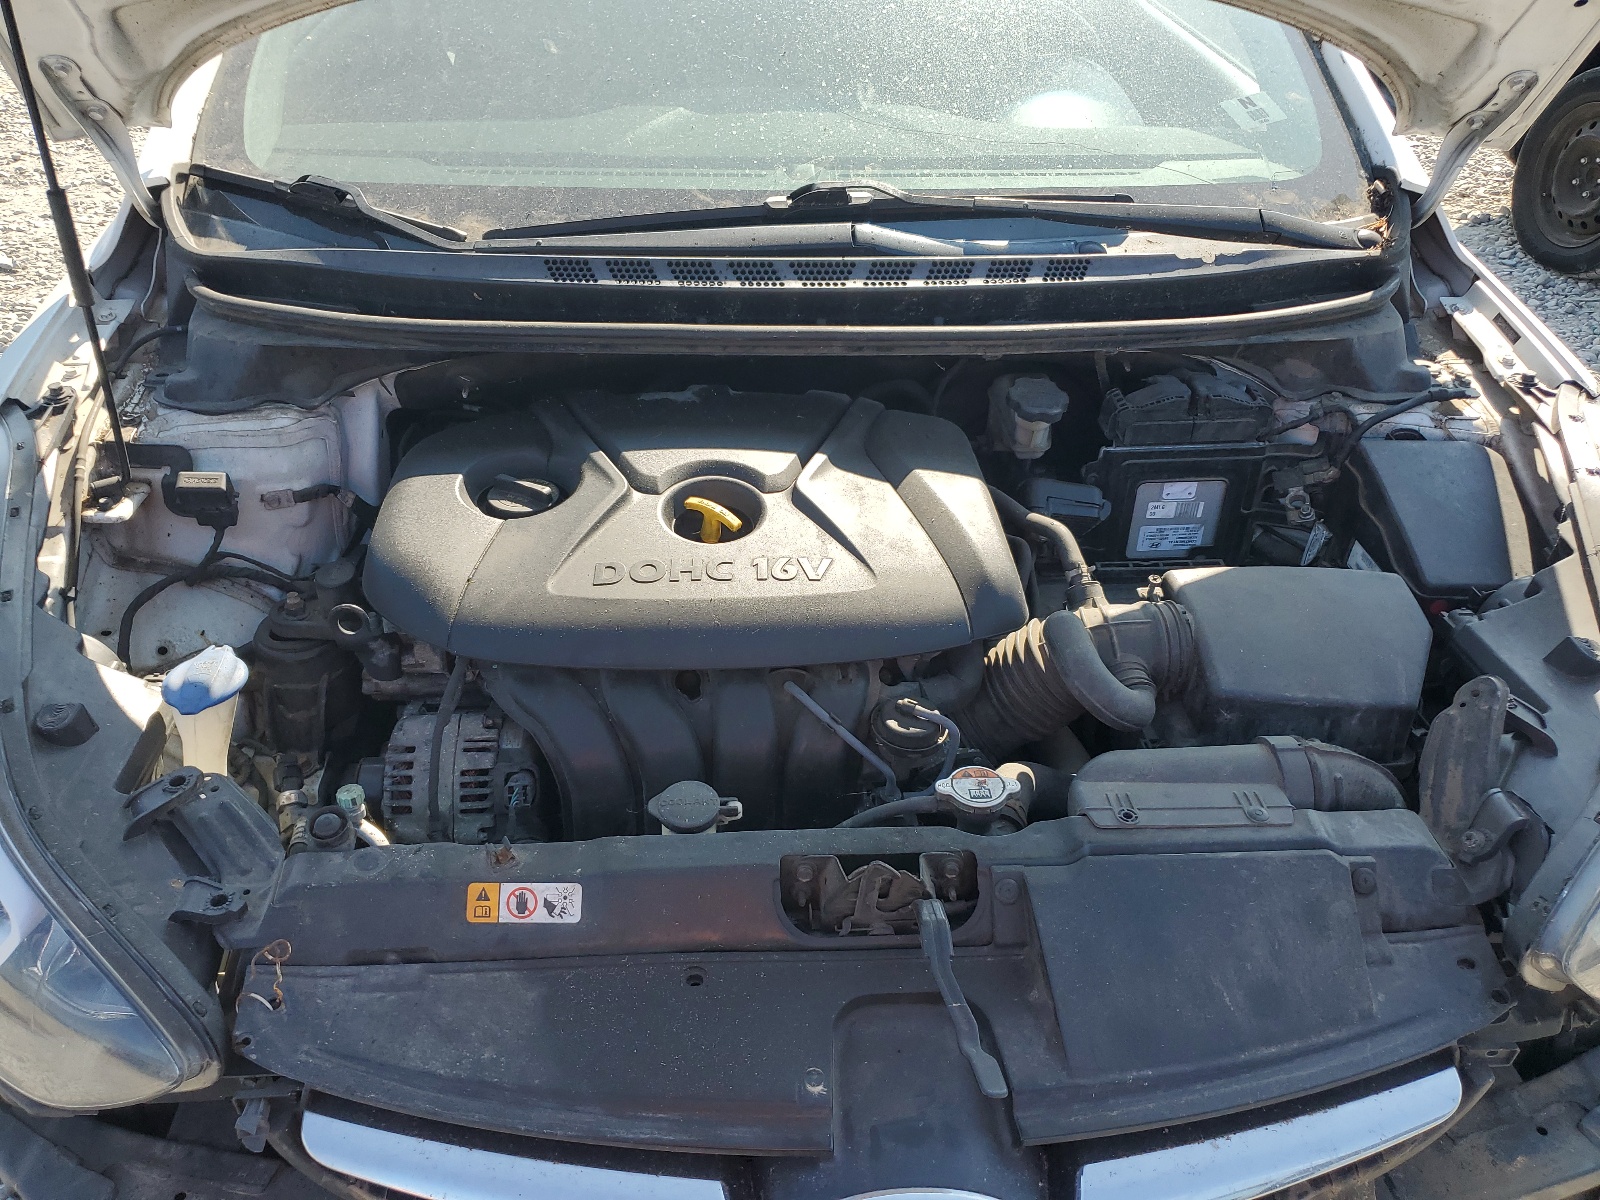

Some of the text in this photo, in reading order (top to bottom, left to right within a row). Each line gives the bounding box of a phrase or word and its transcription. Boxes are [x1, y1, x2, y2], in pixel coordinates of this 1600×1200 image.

[592, 556, 833, 586] DOHC 16V
[660, 797, 719, 807] COOLANT
